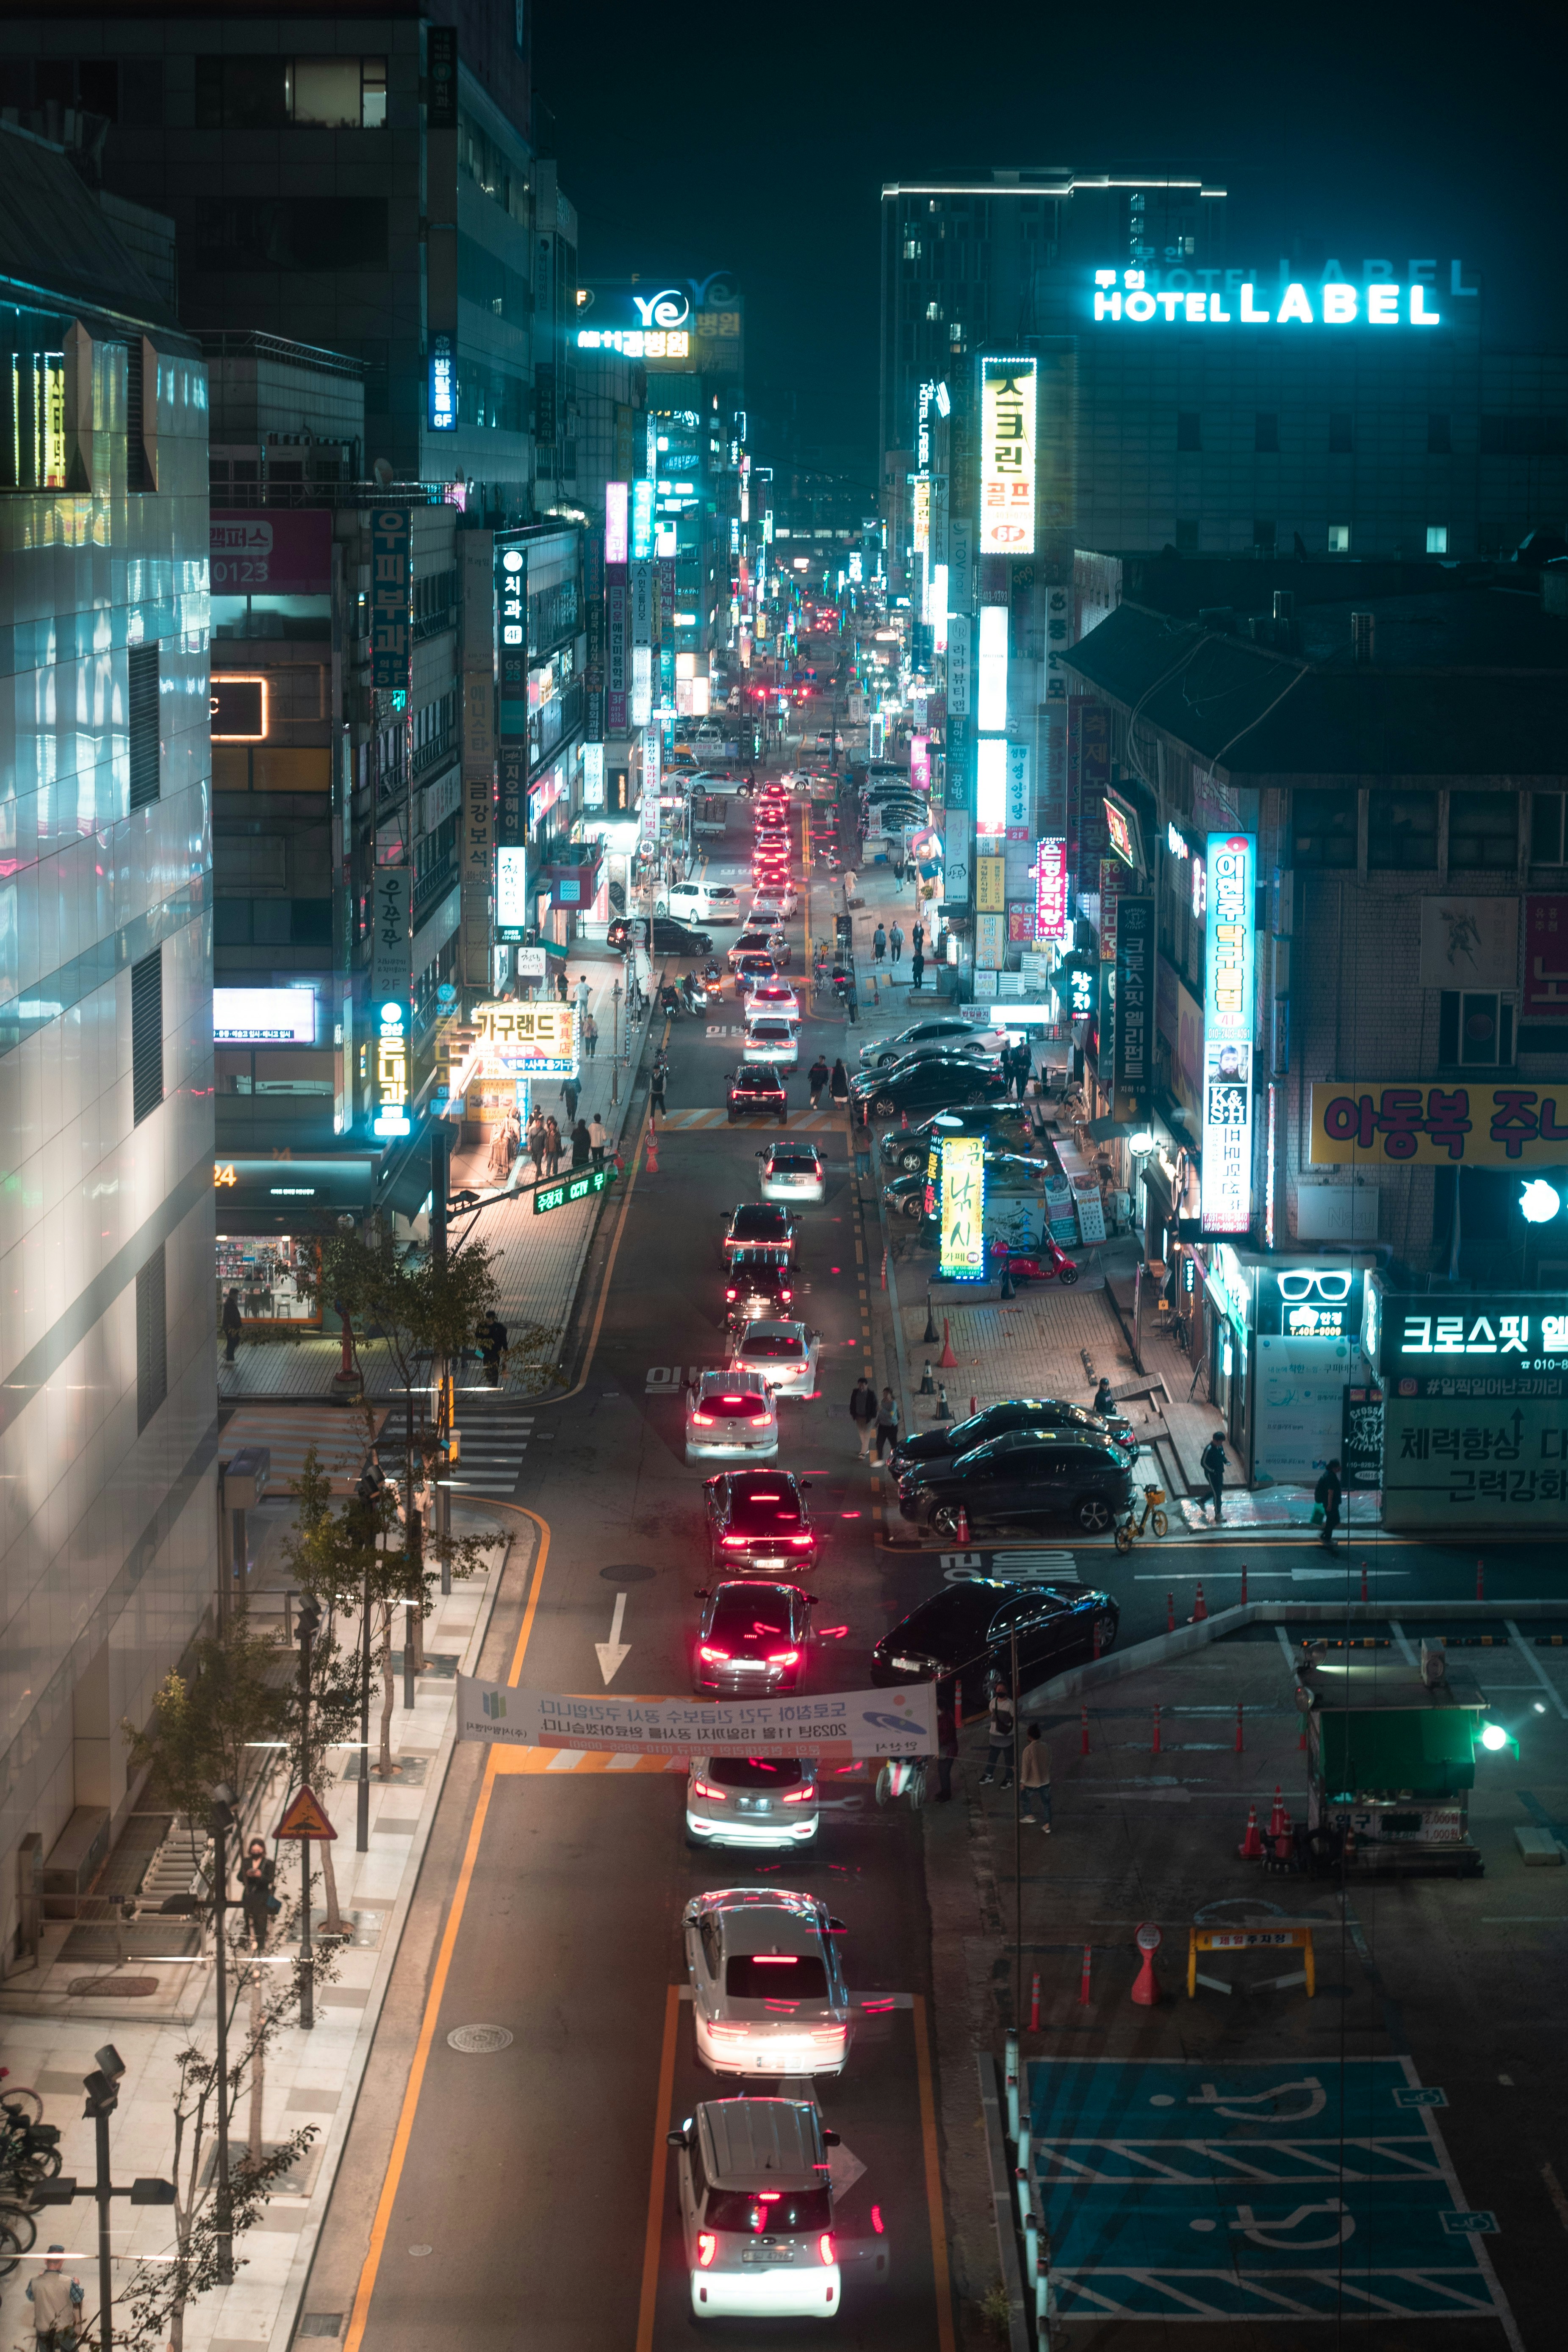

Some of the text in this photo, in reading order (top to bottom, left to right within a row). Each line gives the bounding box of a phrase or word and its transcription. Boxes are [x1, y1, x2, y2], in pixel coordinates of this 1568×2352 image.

[1094, 269, 1146, 289] 무인
[633, 290, 690, 327] Ye
[1094, 283, 1440, 325] HOTEL LABEL
[434, 414, 452, 427] 6F
[919, 383, 929, 468] HOTEL LABEL
[995, 378, 1024, 473] 스크린
[987, 482, 1030, 506] 골프
[610, 552, 624, 562] 4F
[635, 546, 651, 558] 5F
[213, 562, 269, 582] 0123
[374, 513, 407, 655] 우피부과
[504, 576, 522, 619] 치과
[983, 590, 1008, 602] 413-9393
[507, 629, 520, 639] 4F
[590, 635, 598, 661] 마사지
[505, 660, 521, 670] GS
[505, 671, 521, 681] 25
[952, 644, 967, 713] 라라뷰티랩
[612, 695, 624, 704] 3F
[470, 685, 489, 752] 애니스타
[953, 721, 964, 745] 피아노
[647, 765, 657, 787] 마라탕
[505, 765, 519, 829] 지오헤어
[470, 782, 489, 867] 금강보석
[645, 801, 656, 837] 애니벅스
[378, 880, 402, 950] 우쭈쭈
[1216, 855, 1246, 1011] 이현주 탁구클럽
[382, 979, 400, 990] 2F
[1125, 938, 1144, 1079] 크로스핏 엘리펀트
[475, 1014, 555, 1041] 가구랜드
[559, 1012, 571, 1054] 家具店
[1120, 1086, 1133, 1094] 지하
[1324, 1089, 1472, 1159] 아동복
[537, 1173, 604, 1212] 주정차 CCTV 무
[943, 1252, 965, 1262] 카페
[1319, 1311, 1342, 1325] 안경
[1401, 1315, 1529, 1353] 크로스핏
[1426, 1377, 1562, 1395] #일찍일어난코끼리
[1400, 1428, 1525, 1460] 체력향상
[1335, 1814, 1371, 1829] 입구
[1425, 1814, 1458, 1825] 2,000원
[1425, 1829, 1458, 1839] 1,000원
[1247, 1934, 1285, 1944] 주차장
